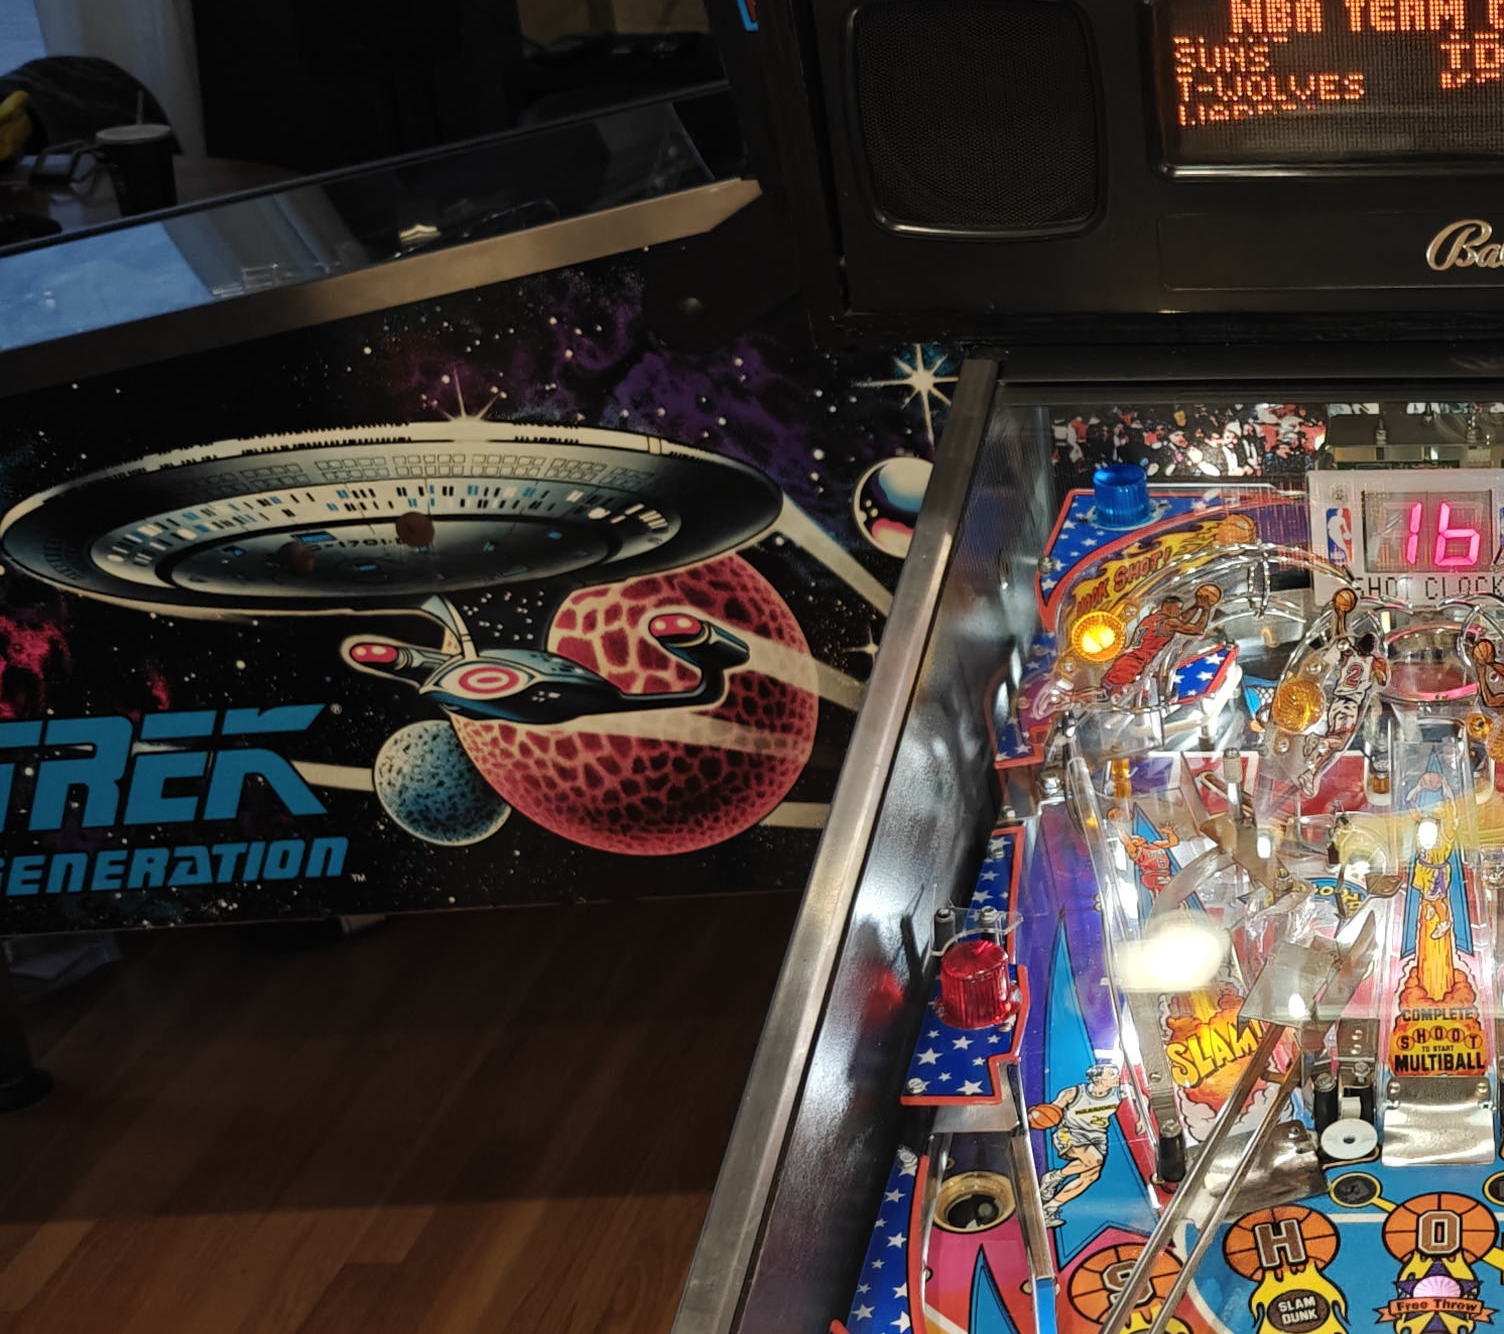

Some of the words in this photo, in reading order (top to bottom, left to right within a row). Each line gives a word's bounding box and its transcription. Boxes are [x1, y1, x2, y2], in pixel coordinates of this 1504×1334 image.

[1176, 73, 1366, 103] T-WOLVES
[1405, 501, 1481, 568] 16
[1356, 575, 1415, 600] SHOT
[1424, 573, 1504, 602] CLOCK
[0, 836, 348, 896] ENERATION
[1401, 1007, 1477, 1022] COMPLETE
[1393, 1050, 1486, 1074] MULTIBALL
[1277, 1296, 1316, 1312] SLAM
[1281, 1307, 1319, 1323] DUNK
